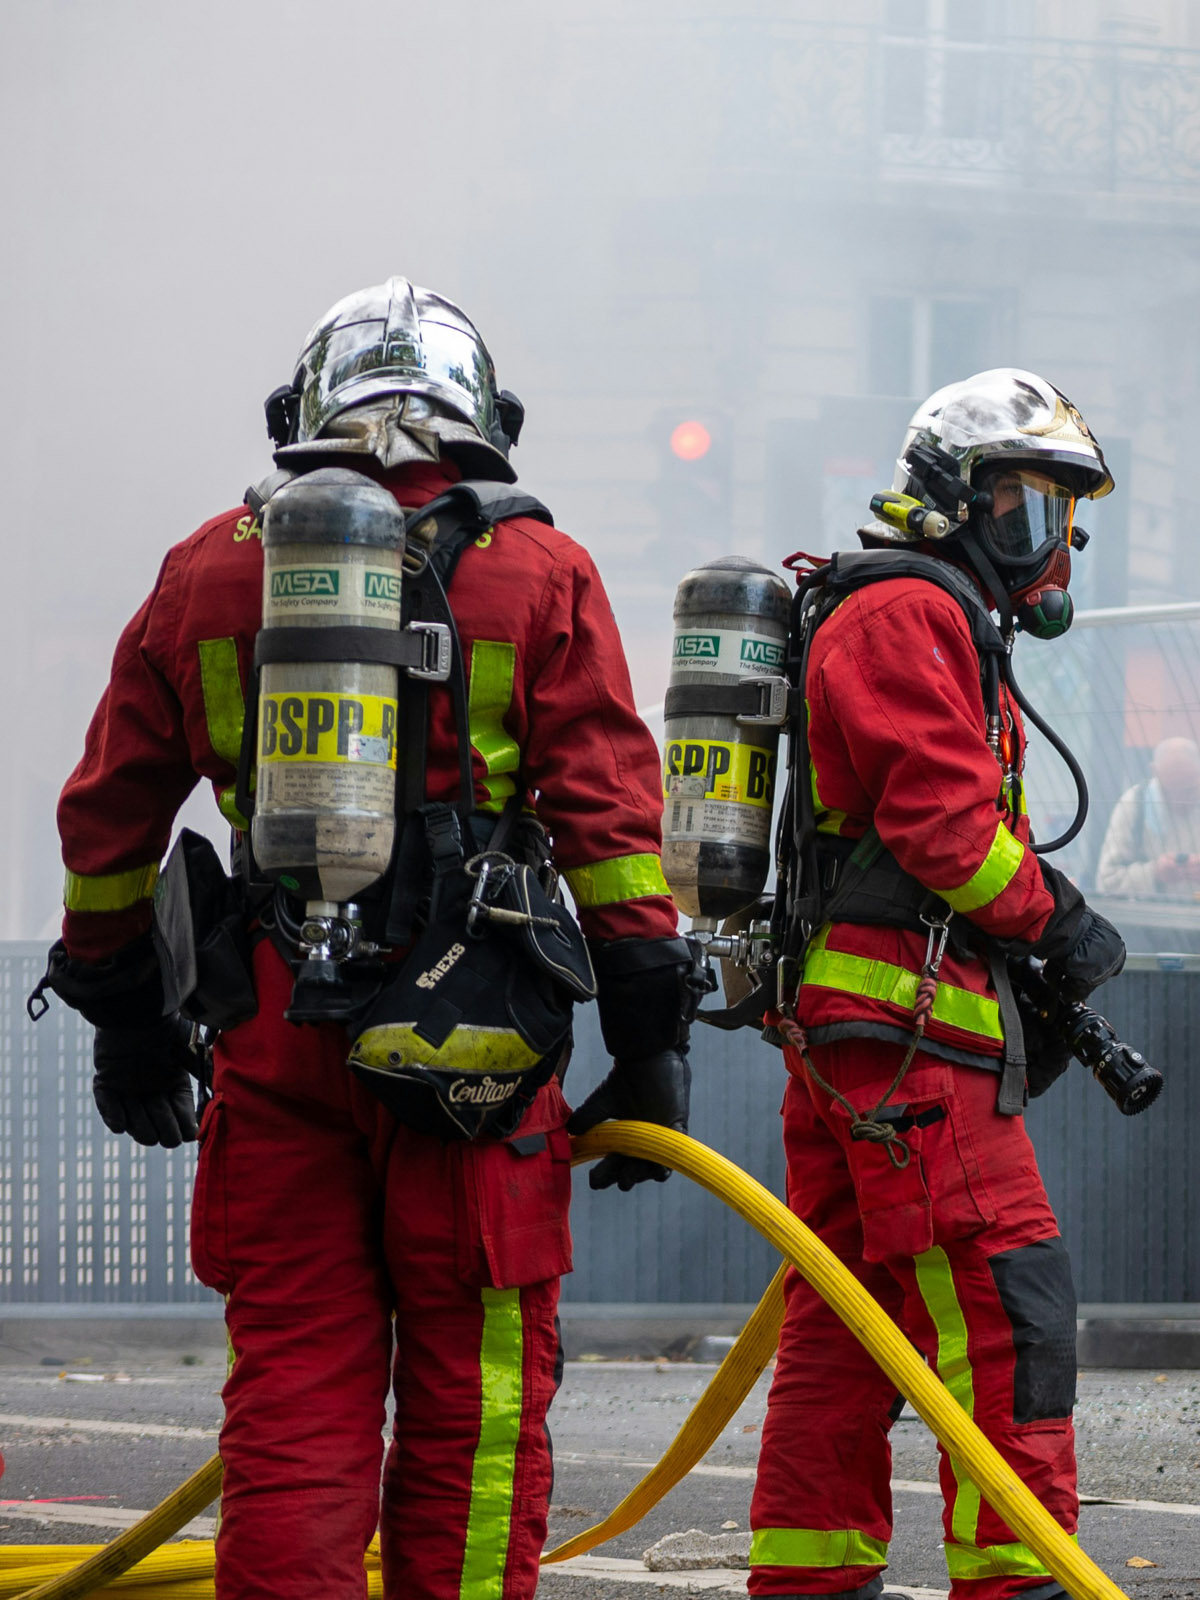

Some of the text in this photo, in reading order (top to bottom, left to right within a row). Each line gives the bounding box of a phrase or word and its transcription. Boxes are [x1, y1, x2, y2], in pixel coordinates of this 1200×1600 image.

[272, 573, 336, 594] MSA
[368, 575, 401, 599] MS
[301, 597, 339, 607] Company
[690, 658, 718, 667] Company
[752, 664, 770, 673] Safety
[261, 697, 364, 756] BSPP
[664, 743, 731, 795] SPP
